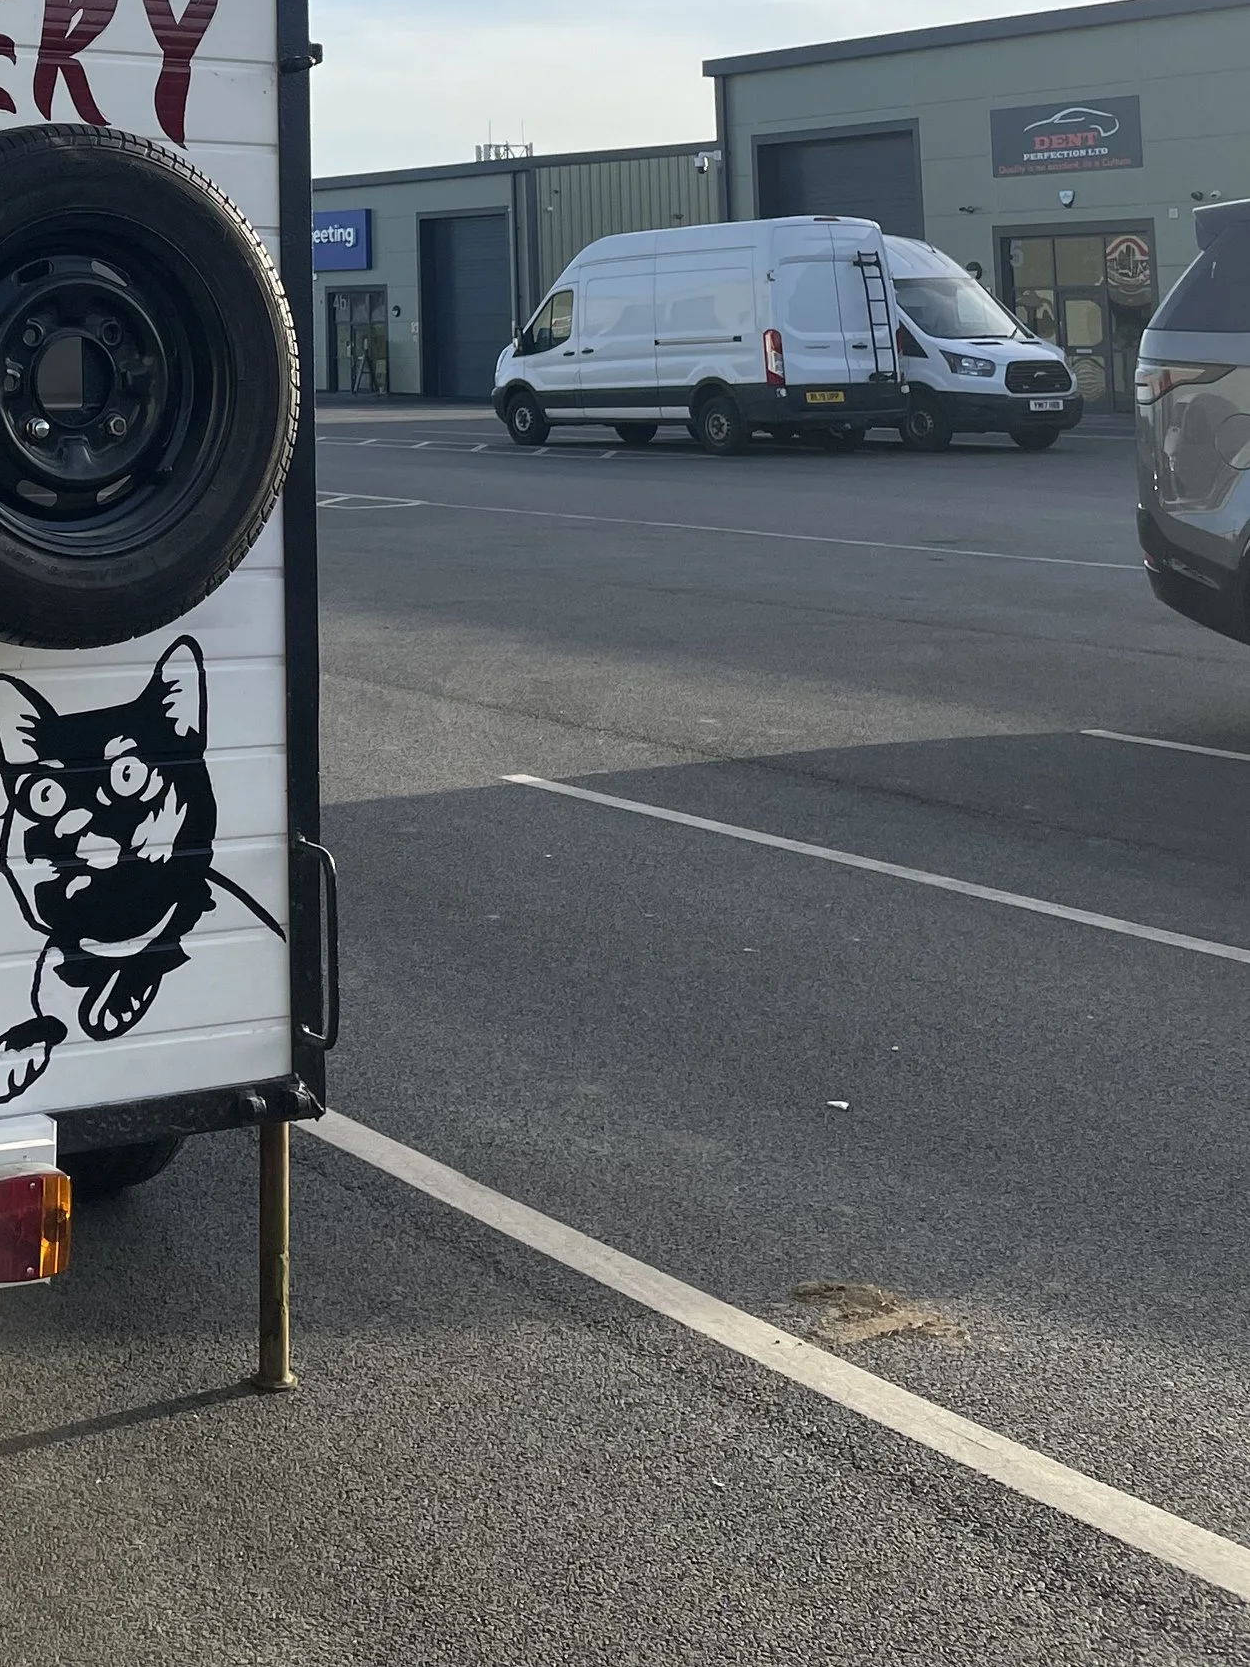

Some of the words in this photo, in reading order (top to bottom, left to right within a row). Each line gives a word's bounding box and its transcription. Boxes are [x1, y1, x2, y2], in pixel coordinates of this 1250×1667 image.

[1033, 132, 1097, 149] DENT
[1023, 150, 1086, 161] PERFECTION
[1088, 147, 1109, 156] LTD
[312, 225, 353, 247] eeting
